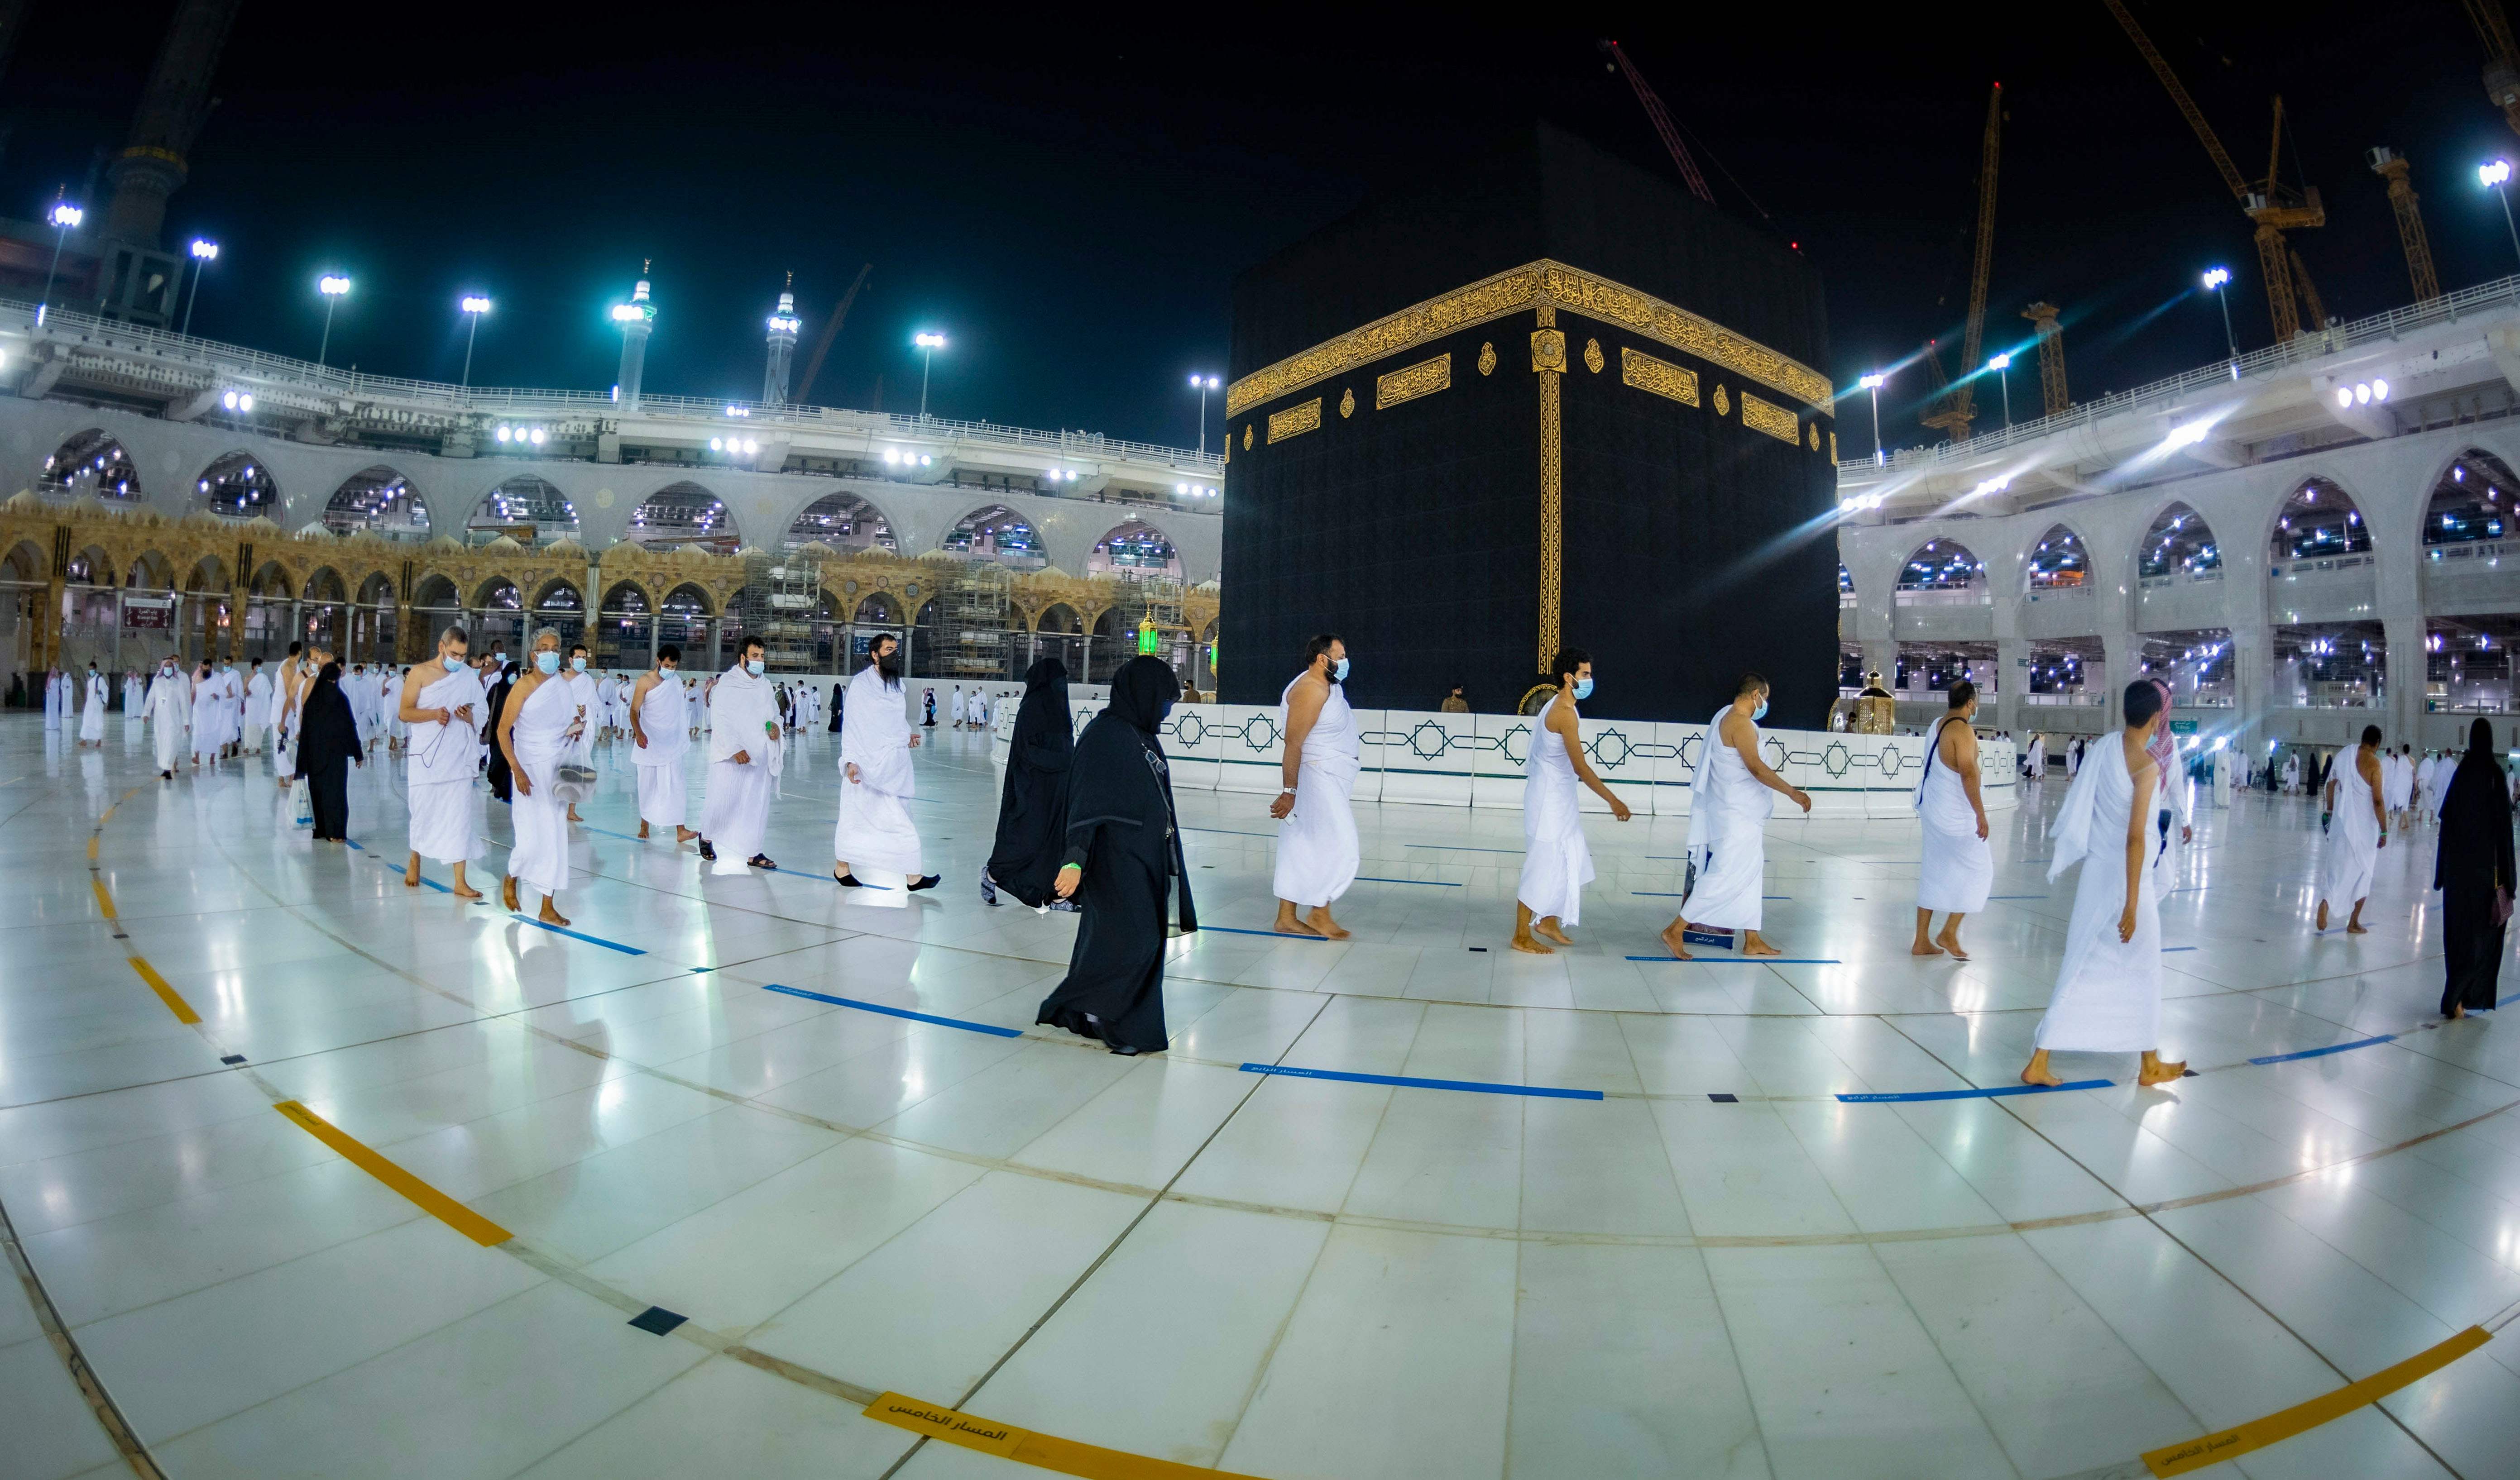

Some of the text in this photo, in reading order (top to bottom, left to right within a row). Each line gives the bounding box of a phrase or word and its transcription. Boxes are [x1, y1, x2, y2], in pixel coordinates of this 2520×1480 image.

[888, 1406, 1008, 1441] المسار الخامس
[2161, 1433, 2241, 1466] المسار الخامس
